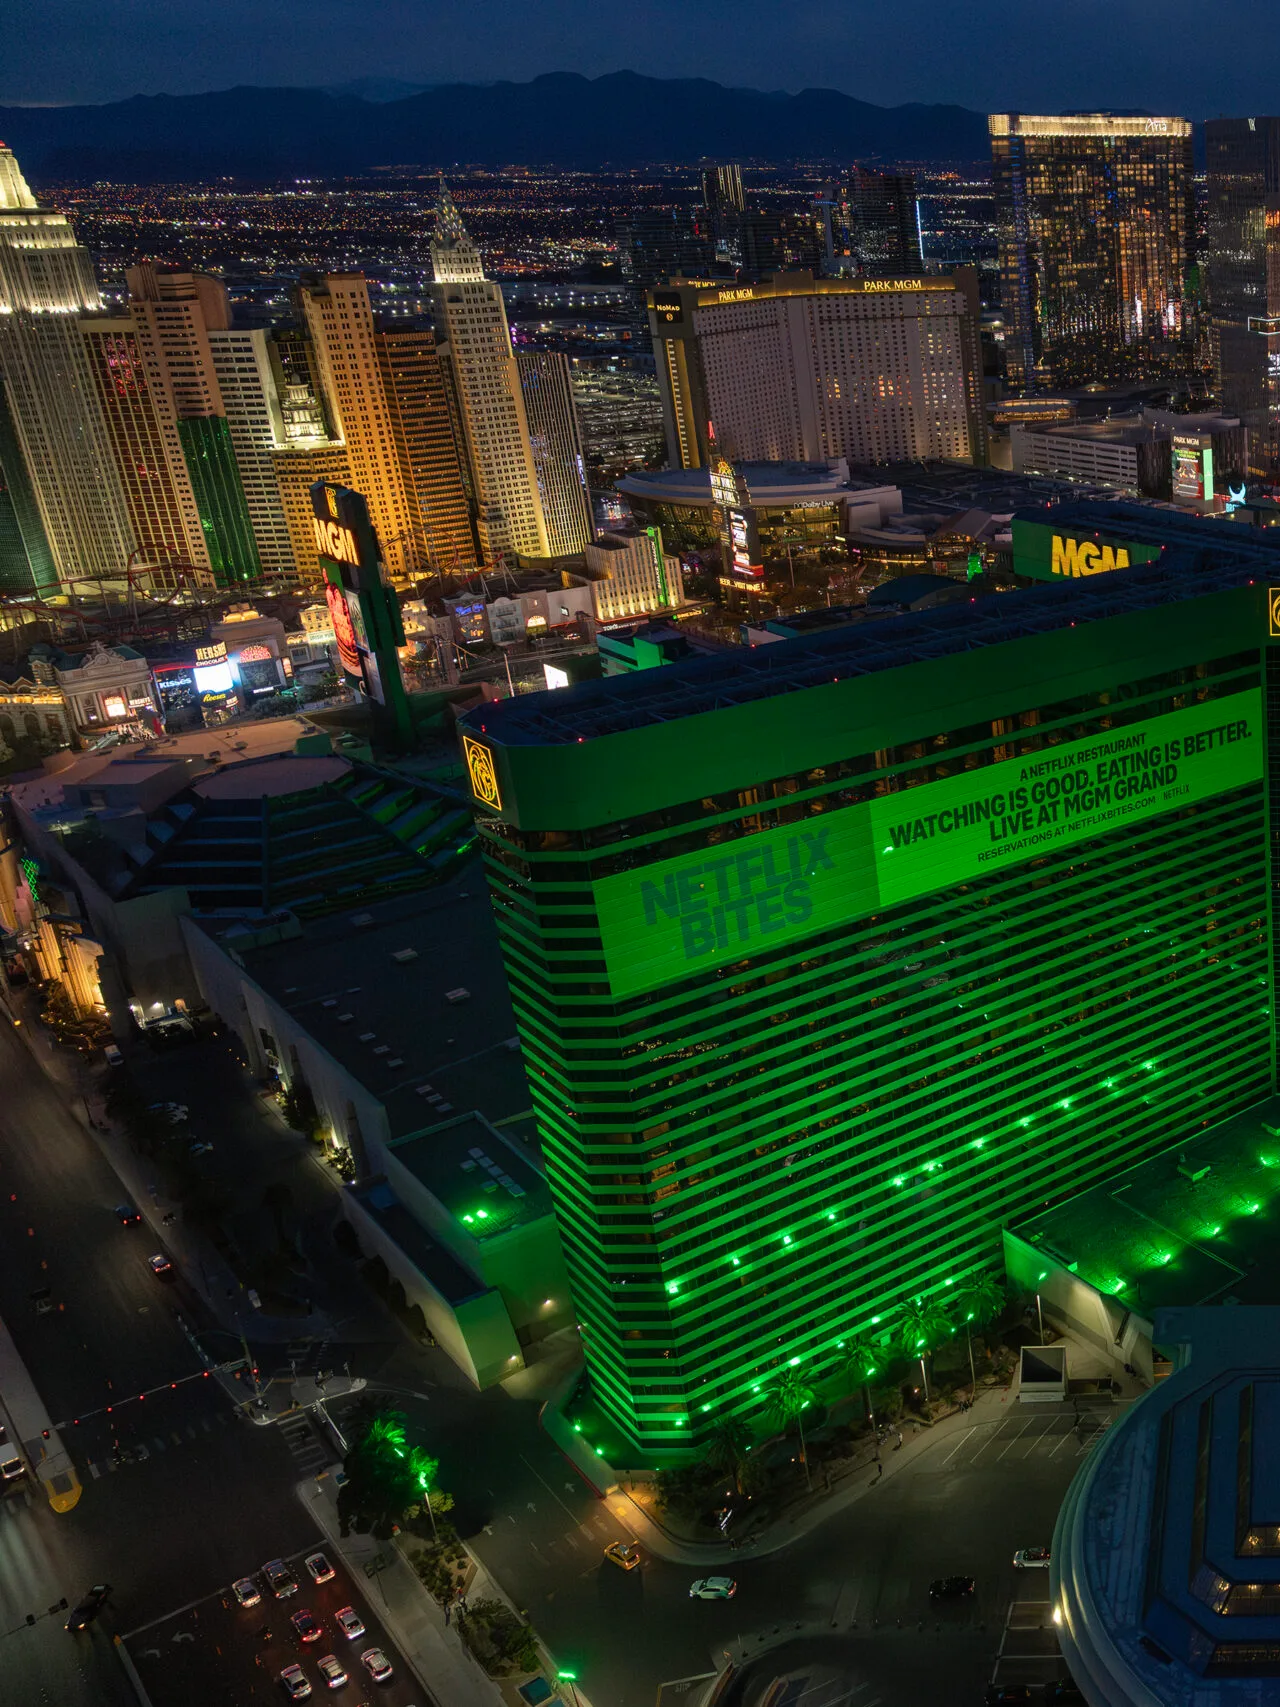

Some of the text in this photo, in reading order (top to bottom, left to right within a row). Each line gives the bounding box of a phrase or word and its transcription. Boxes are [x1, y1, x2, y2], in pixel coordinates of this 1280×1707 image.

[718, 288, 753, 301] PARK MGM
[864, 280, 921, 290] PARK MGM
[1173, 436, 1199, 446] PARK MGM
[313, 517, 360, 566] MGM
[1052, 535, 1130, 578] MGM
[1020, 732, 1147, 781] A NETFLIX RESTAURANT
[889, 720, 1252, 848] WATCHING IS GOOD. EATING IS BETTER.
[989, 764, 1177, 842] LIVE AT MGM GRAND
[1163, 784, 1190, 800] NETFLIX
[977, 796, 1157, 863] RESERVATIONS AT NETFLIXBITES.COM
[640, 828, 838, 925] NETFLIX
[680, 879, 813, 959] BITES
